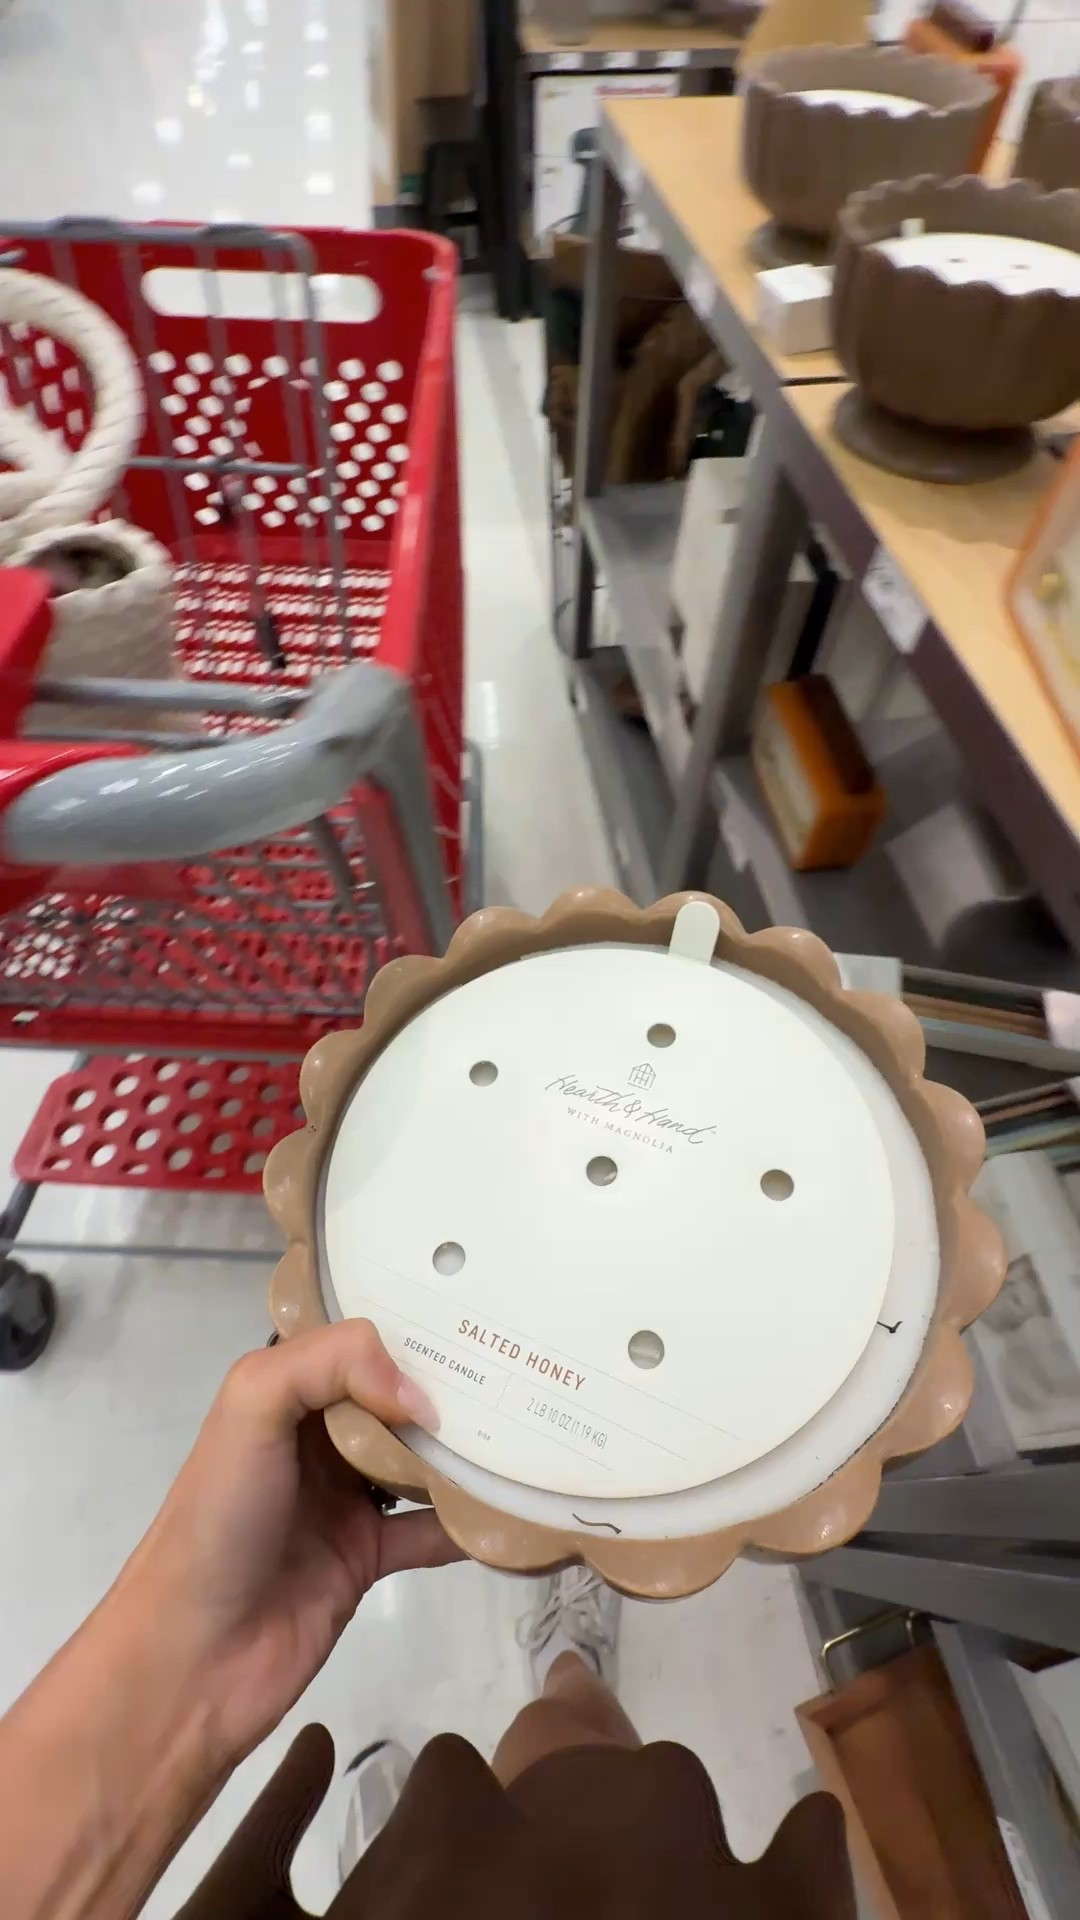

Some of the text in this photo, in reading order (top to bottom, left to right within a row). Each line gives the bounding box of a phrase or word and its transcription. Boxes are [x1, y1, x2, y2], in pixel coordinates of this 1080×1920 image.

[545, 1073, 634, 1112] Hearth
[623, 1099, 642, 1118] &
[567, 1106, 673, 1154] WITH MAGNOLIA
[404, 1337, 487, 1385] SCENTED CANDLE
[458, 1319, 586, 1391] SALTED HONEY
[526, 1397, 535, 1412] 2
[533, 1401, 548, 1417] LB
[547, 1407, 559, 1423] 10
[558, 1413, 572, 1430] OZ
[590, 1429, 608, 1450] KG)
